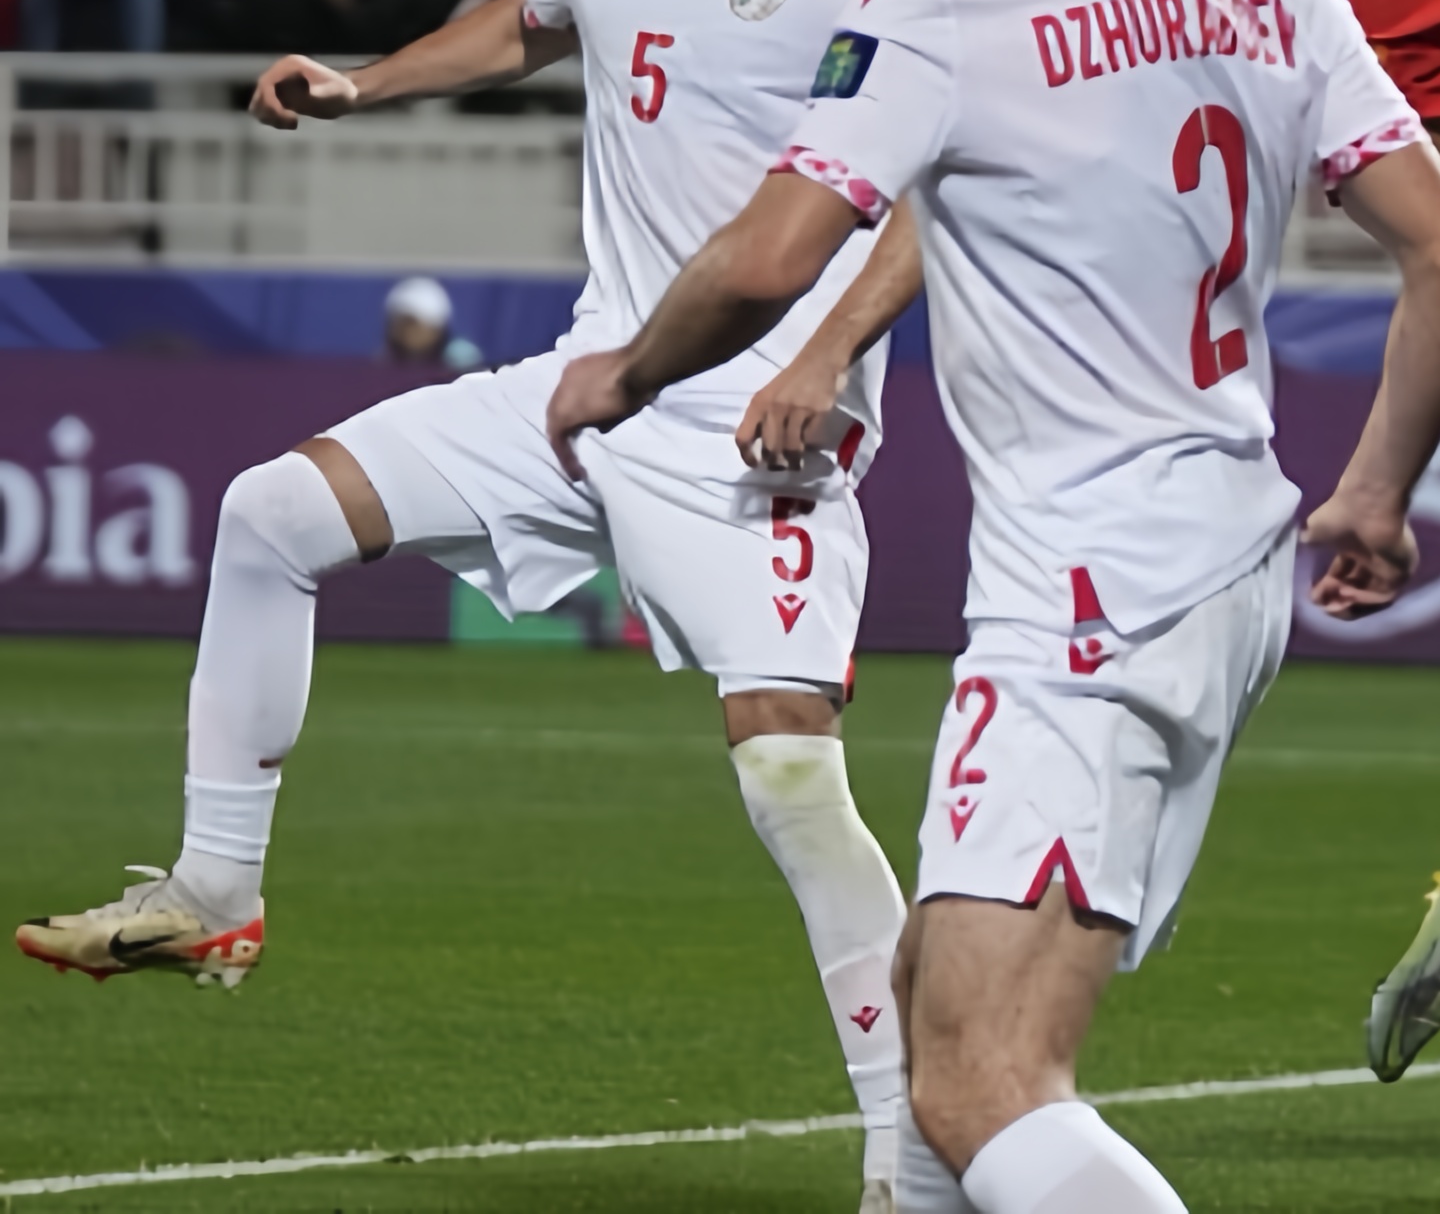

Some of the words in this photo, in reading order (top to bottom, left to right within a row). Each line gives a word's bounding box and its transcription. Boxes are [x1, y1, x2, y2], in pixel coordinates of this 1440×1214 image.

[631, 31, 674, 123] 5
[1173, 104, 1249, 390] 2
[770, 495, 816, 583] 5
[949, 676, 998, 789] 2
